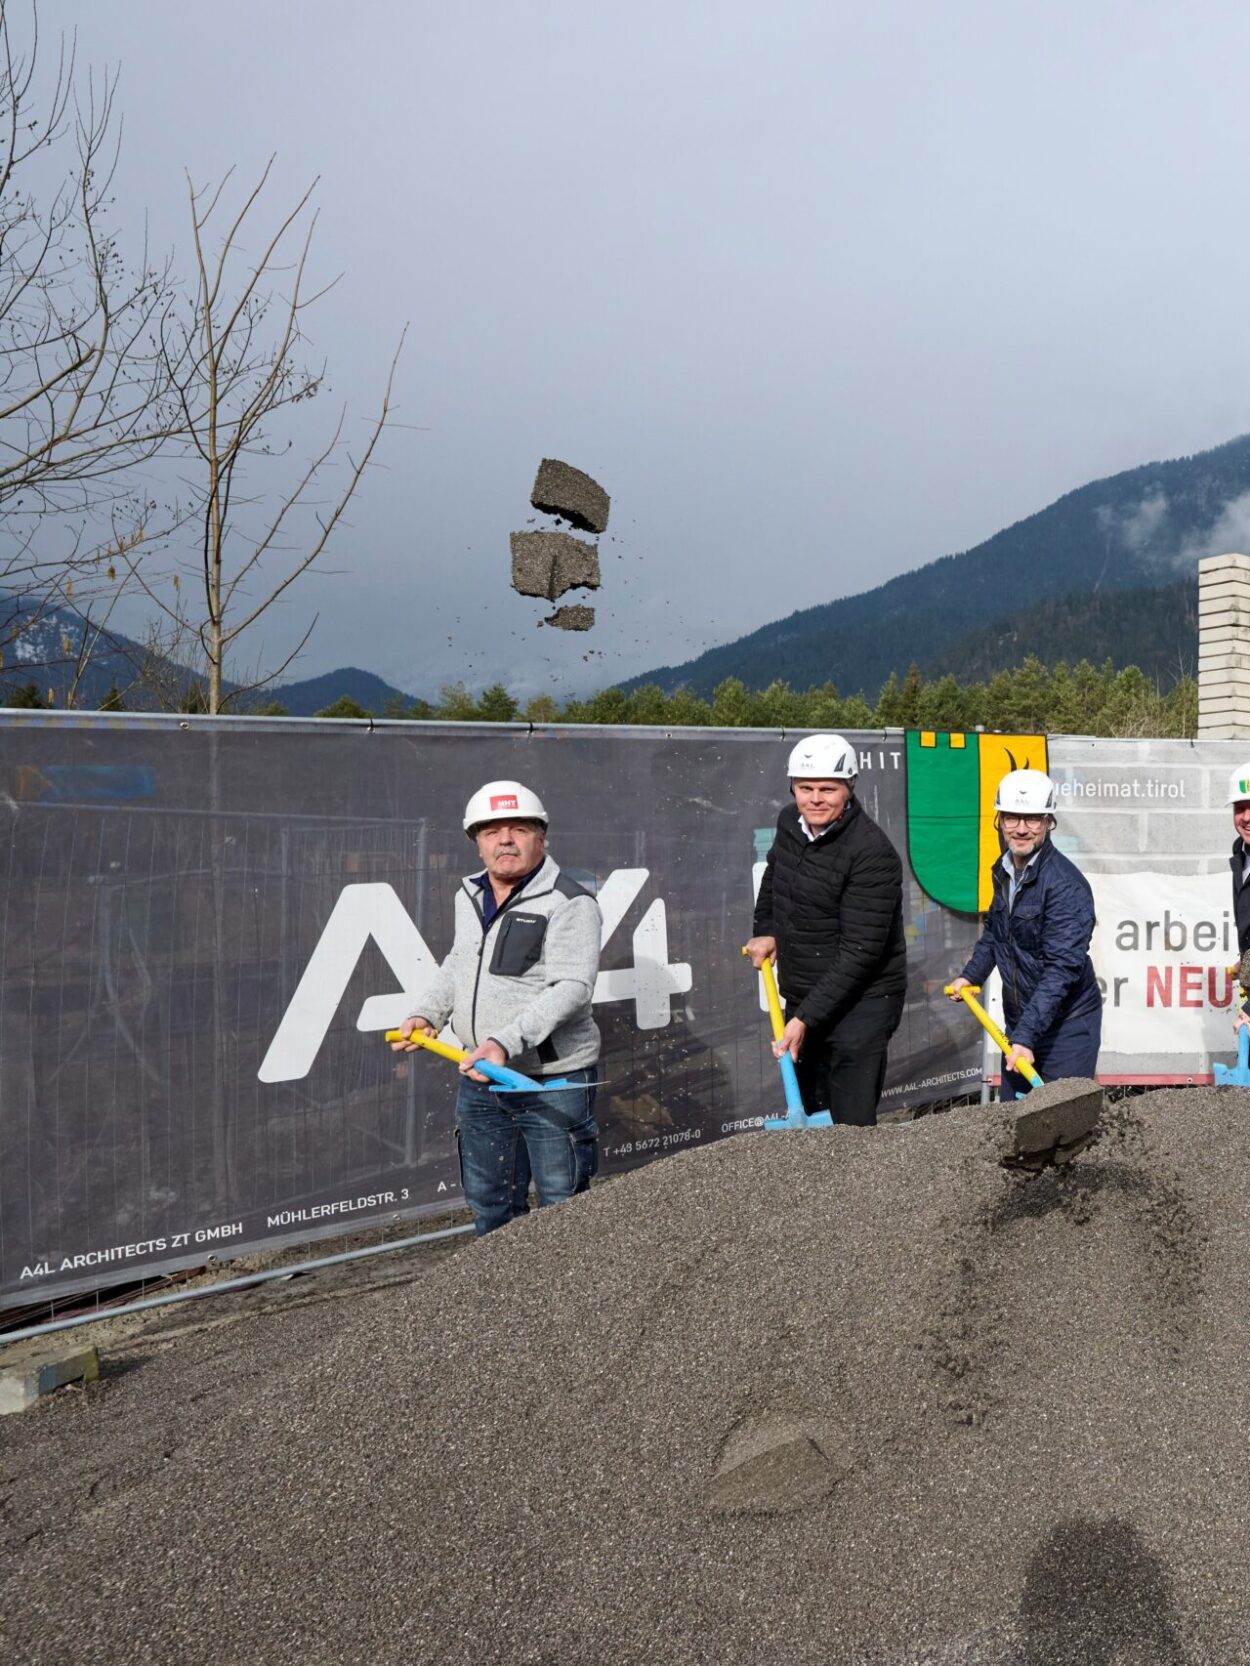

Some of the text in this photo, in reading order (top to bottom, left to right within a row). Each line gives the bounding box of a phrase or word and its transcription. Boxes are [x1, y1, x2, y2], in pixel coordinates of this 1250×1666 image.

[1115, 910, 1237, 952] arbei
[635, 1138, 660, 1151] 5672
[662, 1129, 701, 1147] 21078-0
[20, 1262, 55, 1279] A4L
[60, 1237, 167, 1271] ARCHITECTS
[171, 1233, 190, 1248] ZT
[195, 1222, 243, 1242] GMBH
[267, 1191, 398, 1228] MÜHLERFELDSTR.
[401, 1188, 409, 1200] 3
[437, 1181, 447, 1192] A
